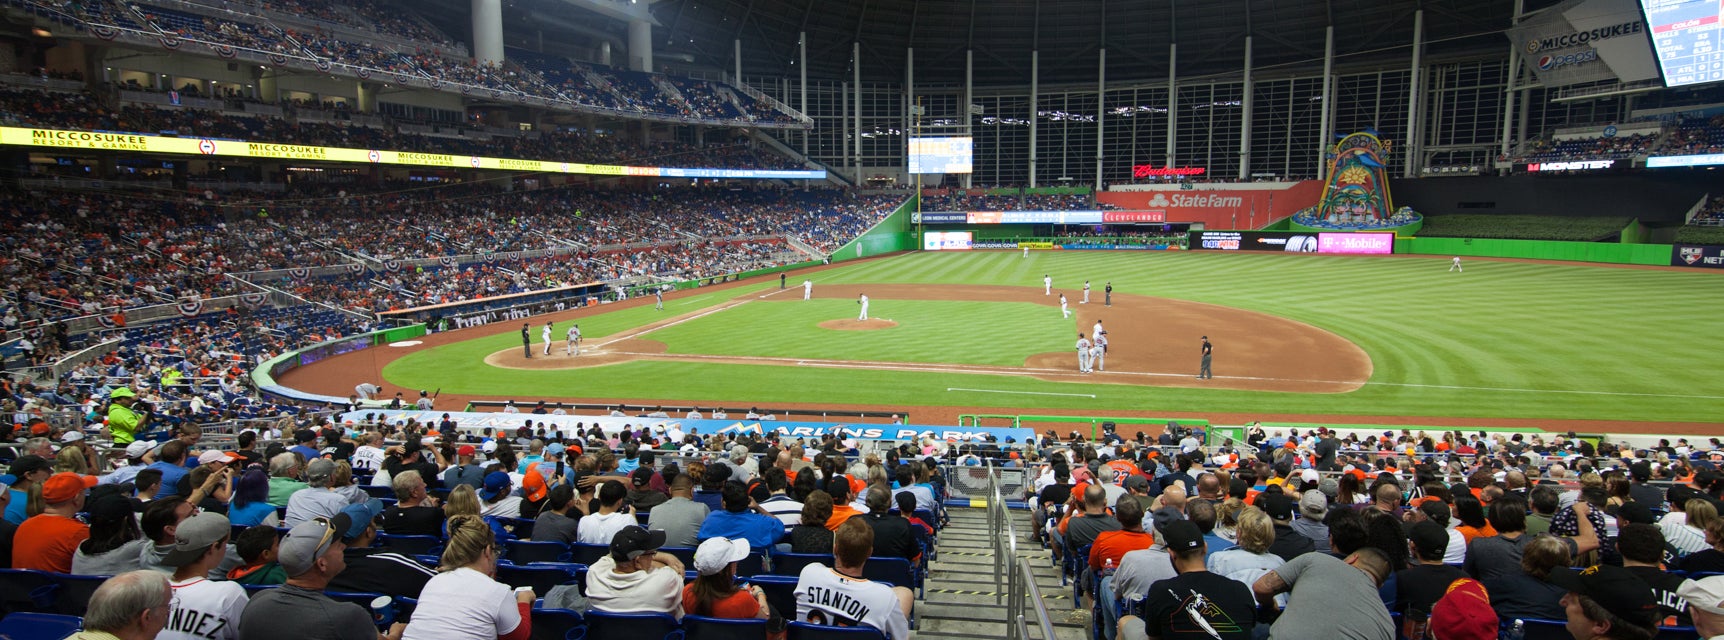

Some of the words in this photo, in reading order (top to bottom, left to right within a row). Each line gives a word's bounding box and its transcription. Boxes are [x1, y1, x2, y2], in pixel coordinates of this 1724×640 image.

[1541, 21, 1641, 50] MICCOSUKEE
[1554, 48, 1597, 68] pepsi
[1677, 66, 1693, 74] ATL
[32, 130, 147, 144] MICCOSUKEE
[1605, 128, 1616, 136] 42
[32, 139, 81, 147] RESORT
[102, 142, 147, 150] GAMING
[249, 143, 327, 154] MICCOSUKEE
[398, 152, 453, 161] MICCOSUKEE
[1133, 164, 1206, 177] Budweiser
[1540, 160, 1612, 171] MONSTER
[1104, 212, 1162, 222] CLEVELANDER
[808, 586, 870, 622] STANTON
[1651, 588, 1688, 612] LICH
[165, 608, 227, 640] NDEZ
